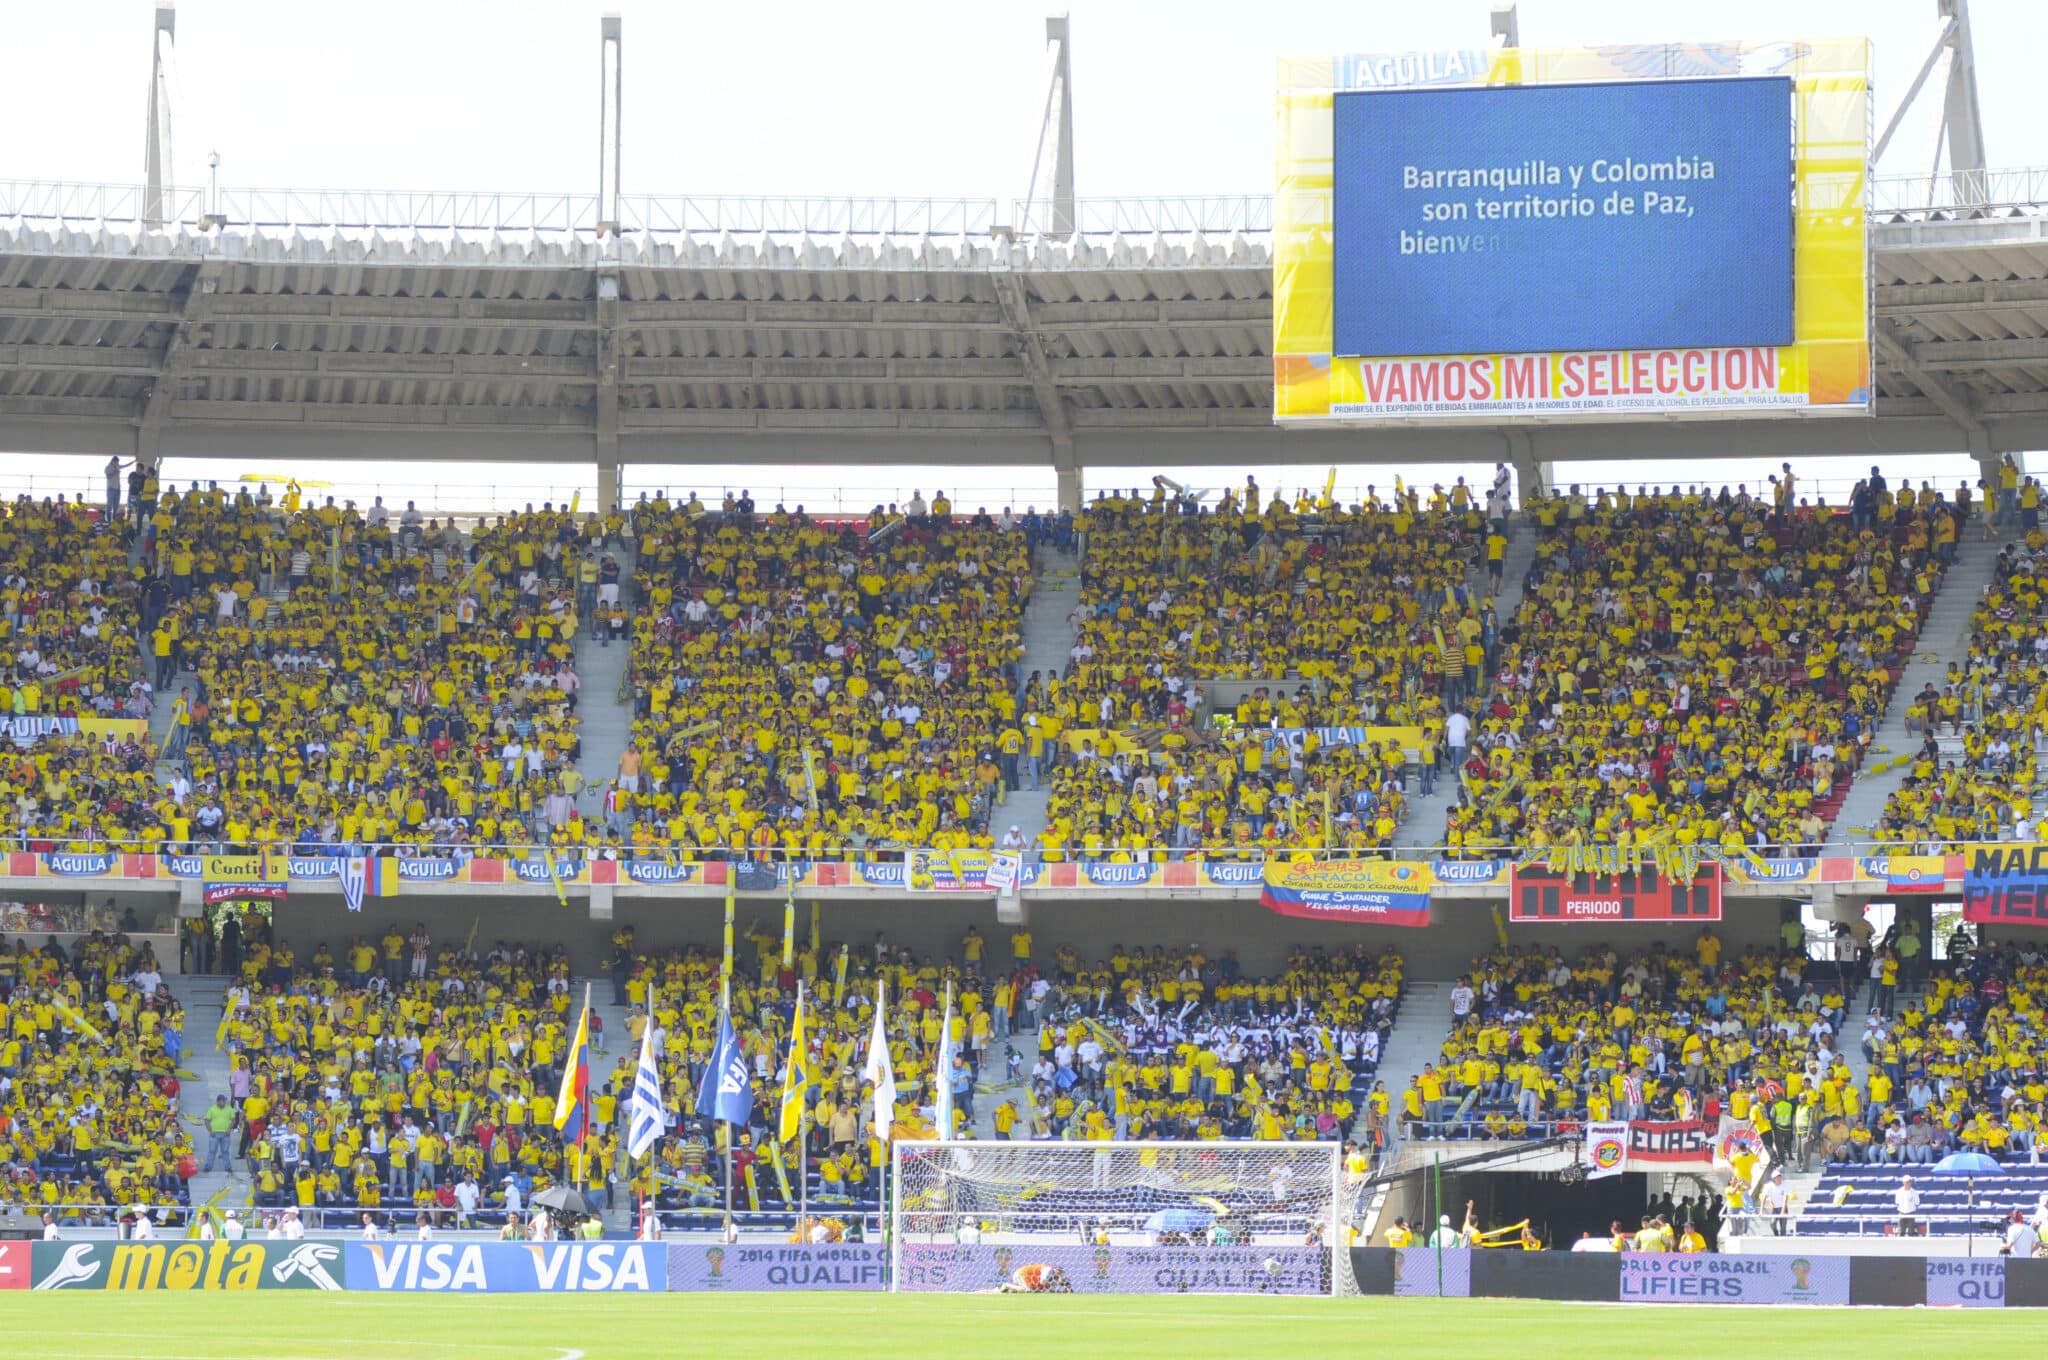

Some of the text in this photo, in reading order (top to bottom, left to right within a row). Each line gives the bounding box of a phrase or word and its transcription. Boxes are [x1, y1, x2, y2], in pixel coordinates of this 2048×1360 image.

[1355, 50, 1465, 88] AGUILA
[1403, 156, 1715, 191] Barranquilla y Colombia
[1423, 190, 1694, 221] son territorio de Paz,
[1363, 347, 1776, 403] VAMOS MI SELECCION
[1424, 403, 1433, 411] DE
[1435, 402, 1467, 411] BEBIDAS
[1535, 400, 1570, 409] MENORES
[1572, 400, 1582, 408] DE
[51, 856, 107, 872] AGUILA
[172, 856, 201, 873] AGU
[287, 857, 338, 875] AGUILA
[399, 859, 453, 877] AGUILA
[519, 861, 574, 878] AGULA
[632, 863, 688, 880] AGUILA
[1439, 864, 1494, 881] AGUILA
[866, 864, 905, 882] AGUI
[1092, 865, 1146, 881] AGUILA
[1212, 865, 1265, 881] AGUILA
[1287, 872, 1373, 882] CARACOL
[1566, 900, 1620, 915] PERIODO
[1632, 1126, 1701, 1153] ELIAS
[106, 1239, 267, 1290] mota
[739, 1250, 774, 1262] 2014
[780, 1250, 812, 1262] FIFA
[817, 1250, 872, 1262] WORLD
[361, 1243, 487, 1290] VISA
[522, 1243, 650, 1290] VISA
[1668, 1260, 1703, 1272] CUP
[1708, 1260, 1770, 1274] BRAZIL
[1927, 1262, 1965, 1276] 2014
[1622, 1276, 1743, 1297] LIFIERS
